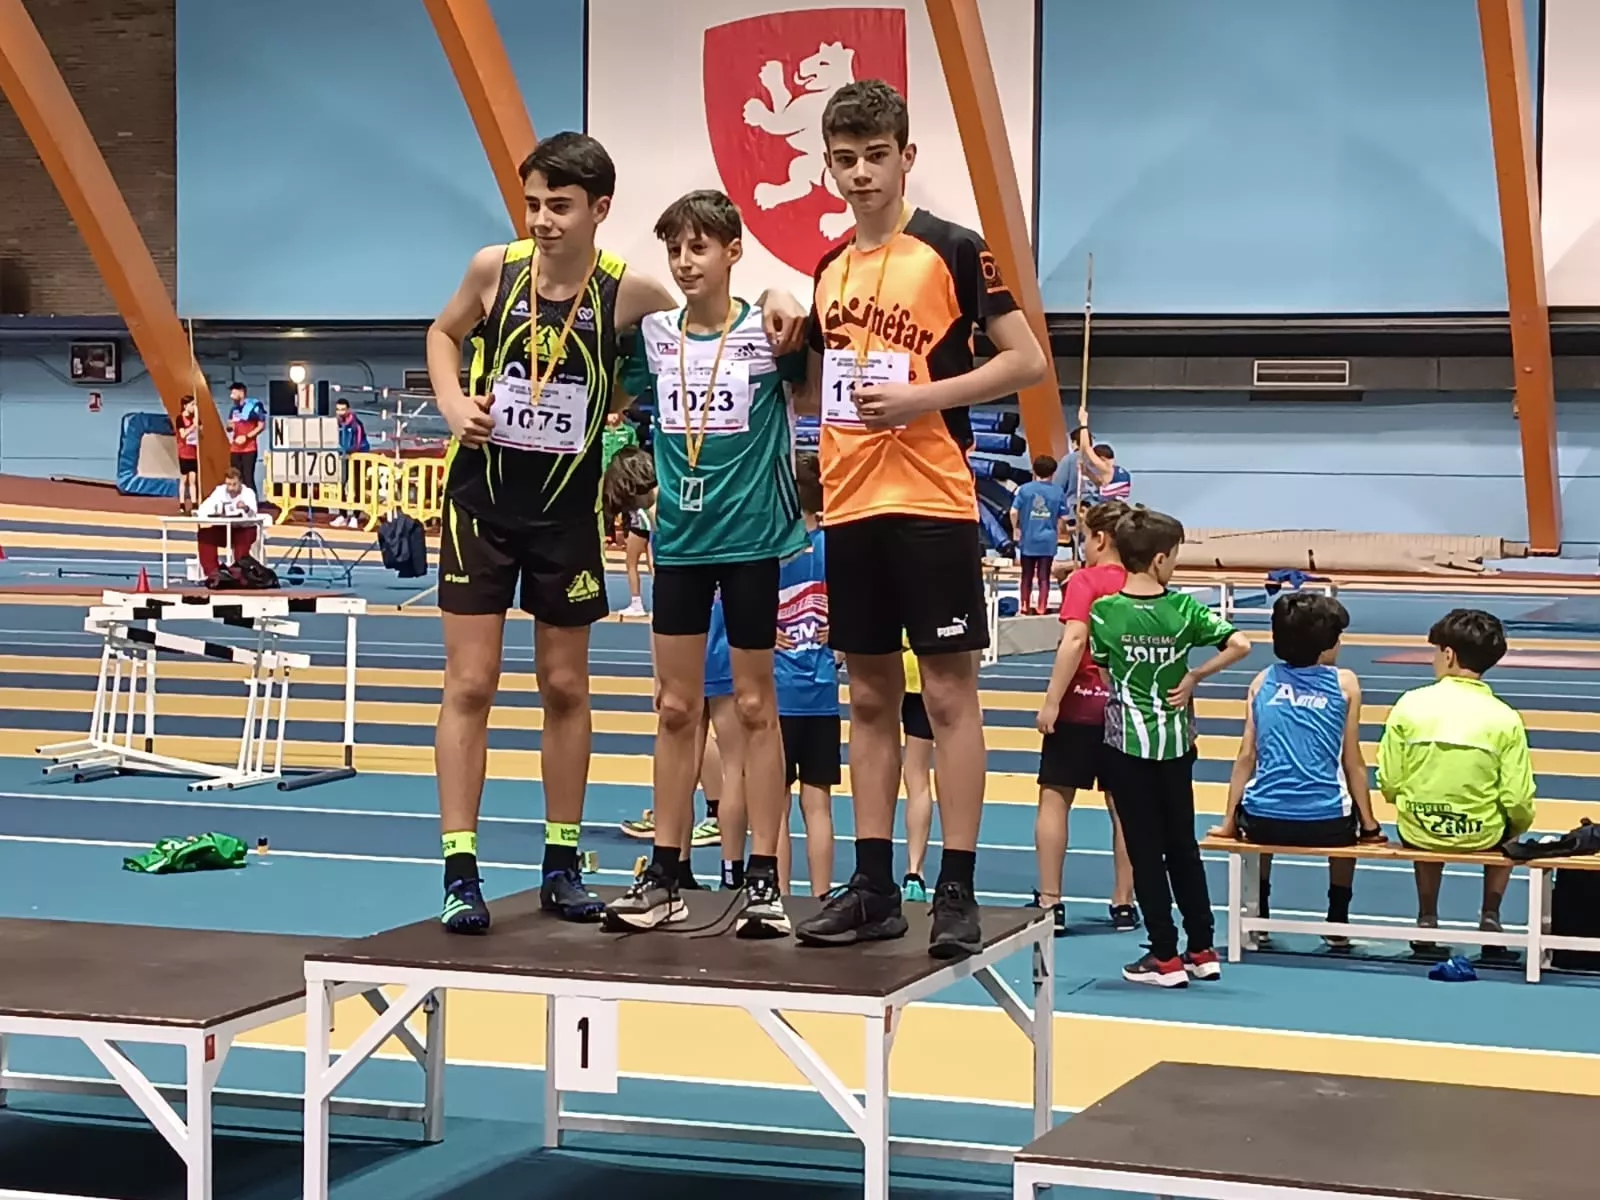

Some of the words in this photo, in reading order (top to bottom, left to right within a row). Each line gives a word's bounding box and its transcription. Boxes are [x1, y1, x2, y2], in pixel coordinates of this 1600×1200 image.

[668, 389, 734, 412] 1023
[274, 418, 284, 446] N
[502, 406, 572, 433] 1075
[291, 451, 337, 476] 170
[577, 1017, 589, 1069] 1
